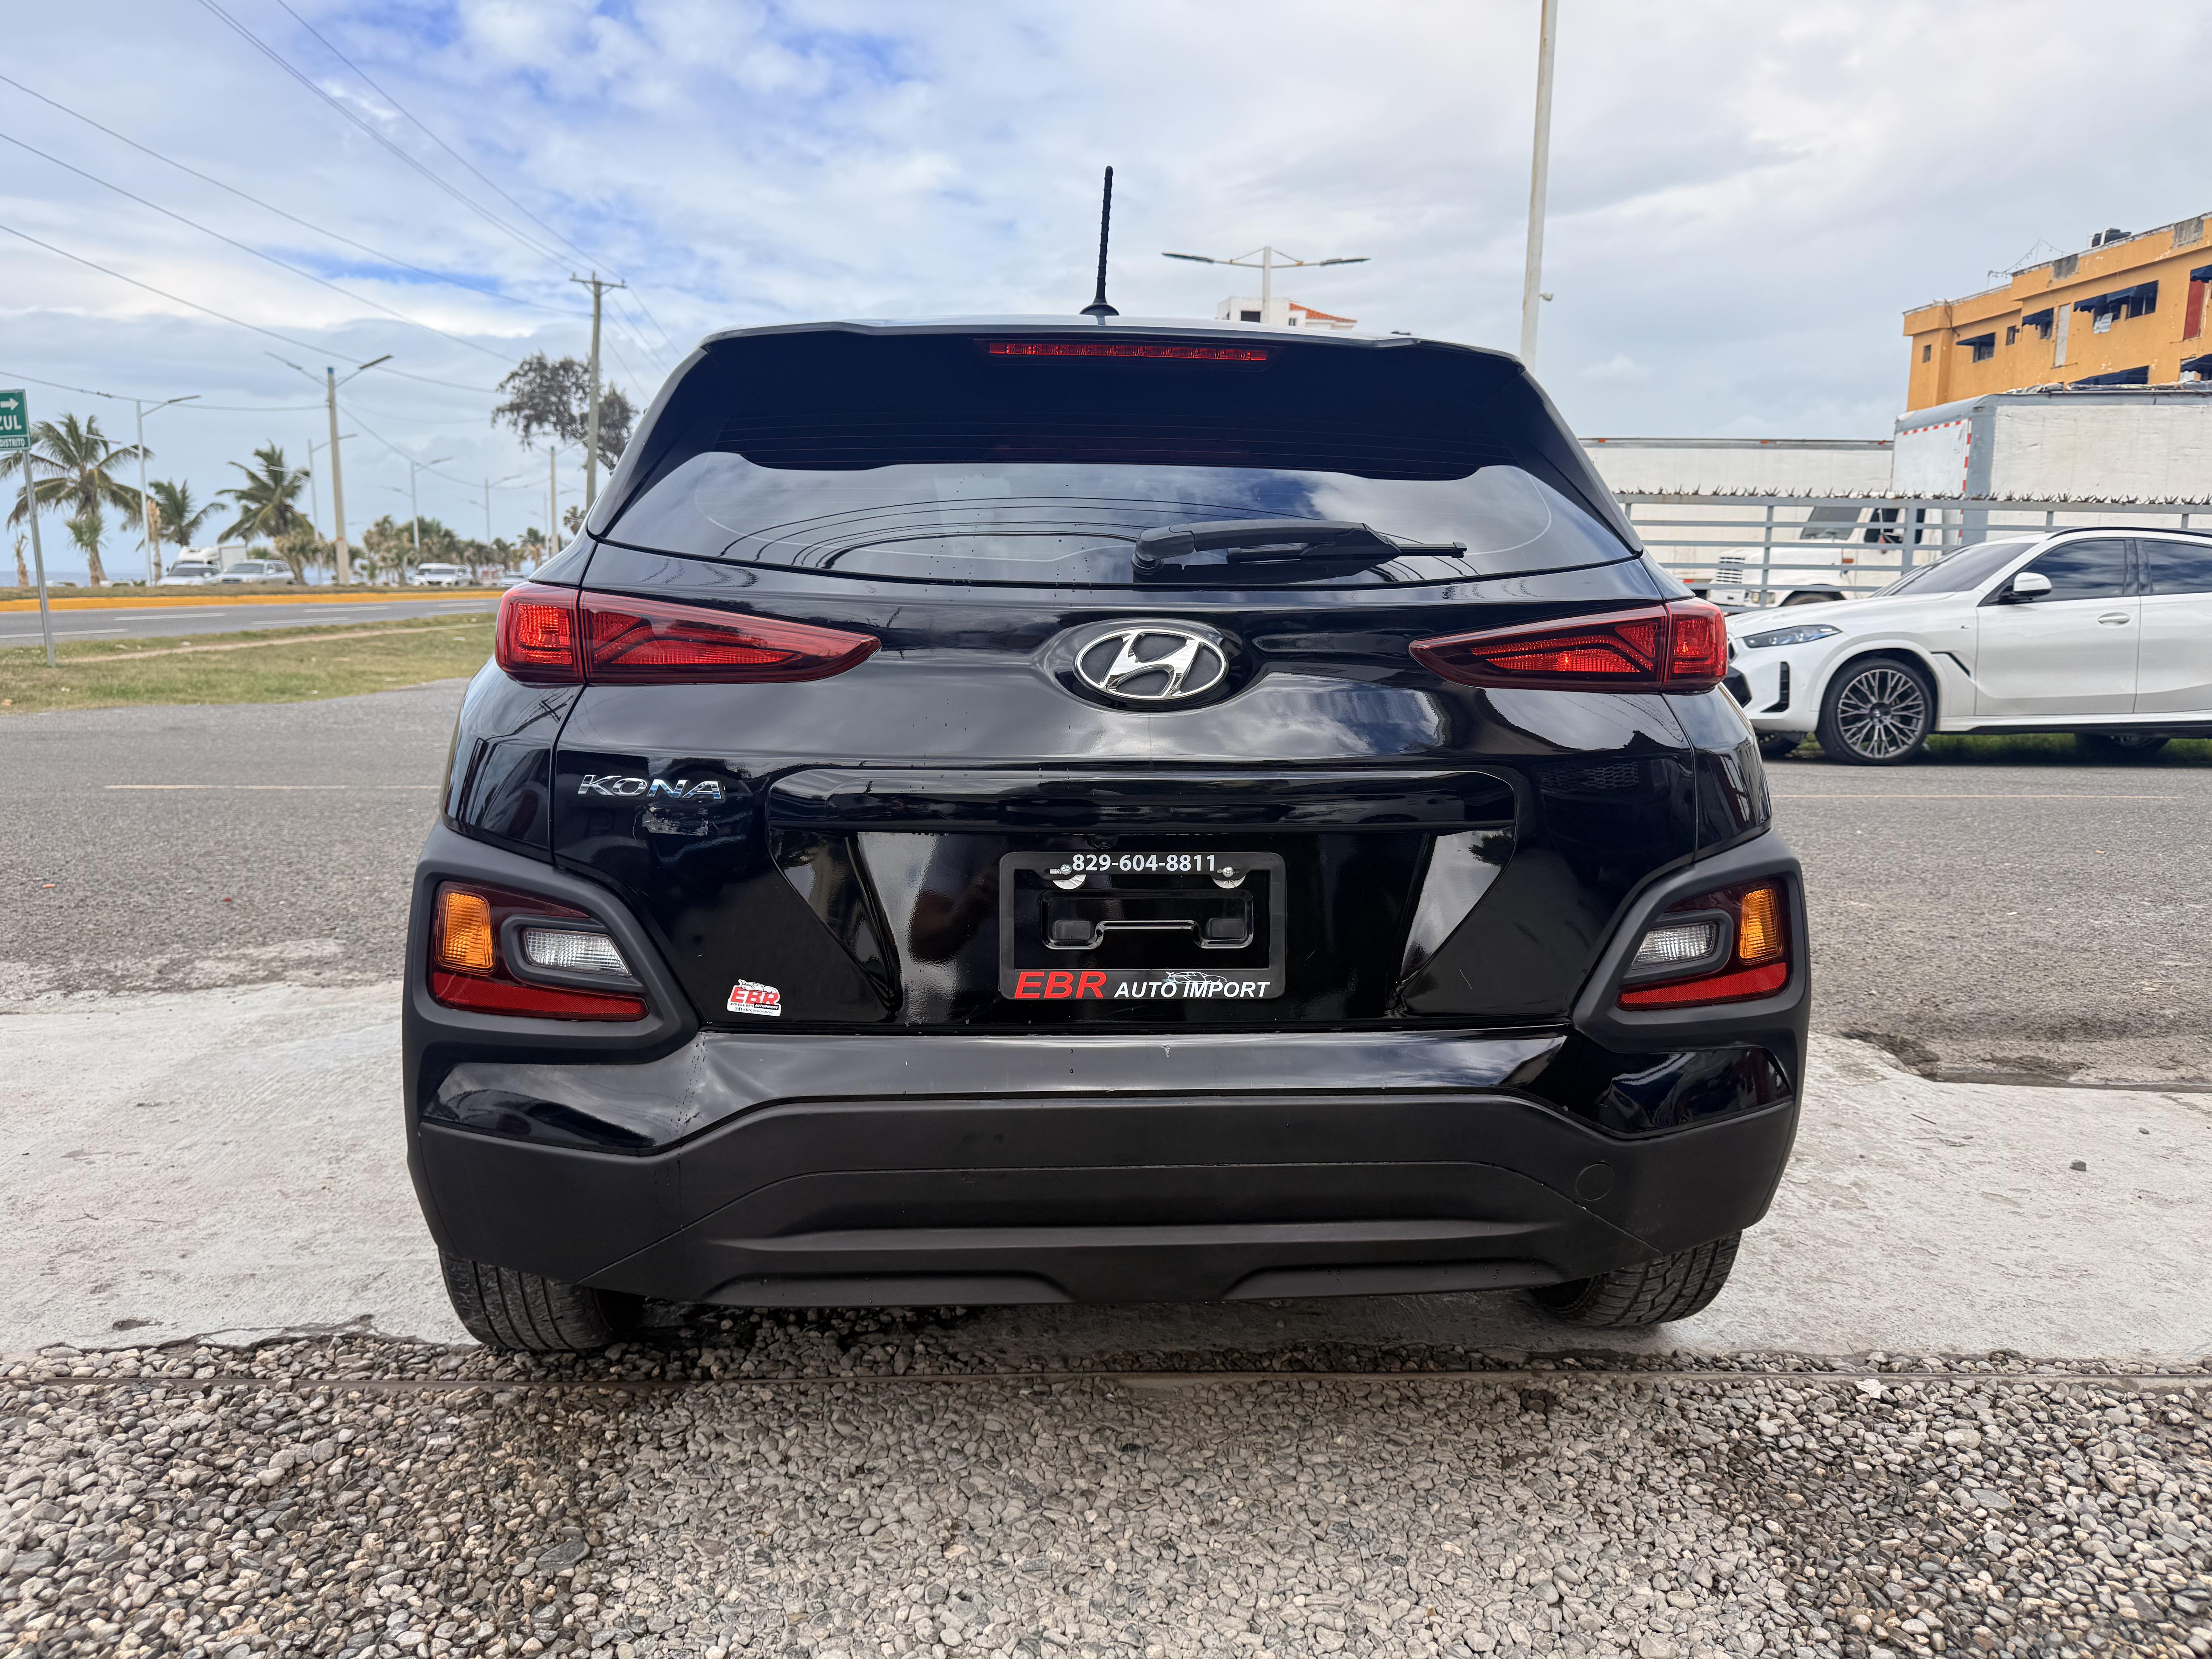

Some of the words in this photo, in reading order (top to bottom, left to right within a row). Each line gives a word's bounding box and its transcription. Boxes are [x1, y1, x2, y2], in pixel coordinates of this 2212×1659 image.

[578, 775, 722, 800] KONA
[1072, 854, 1215, 872] 829-604-8811
[1014, 971, 1107, 999] EBR
[1114, 982, 1177, 998] AUTO
[1183, 981, 1271, 998] IMPORT
[730, 987, 778, 1005] EBR
